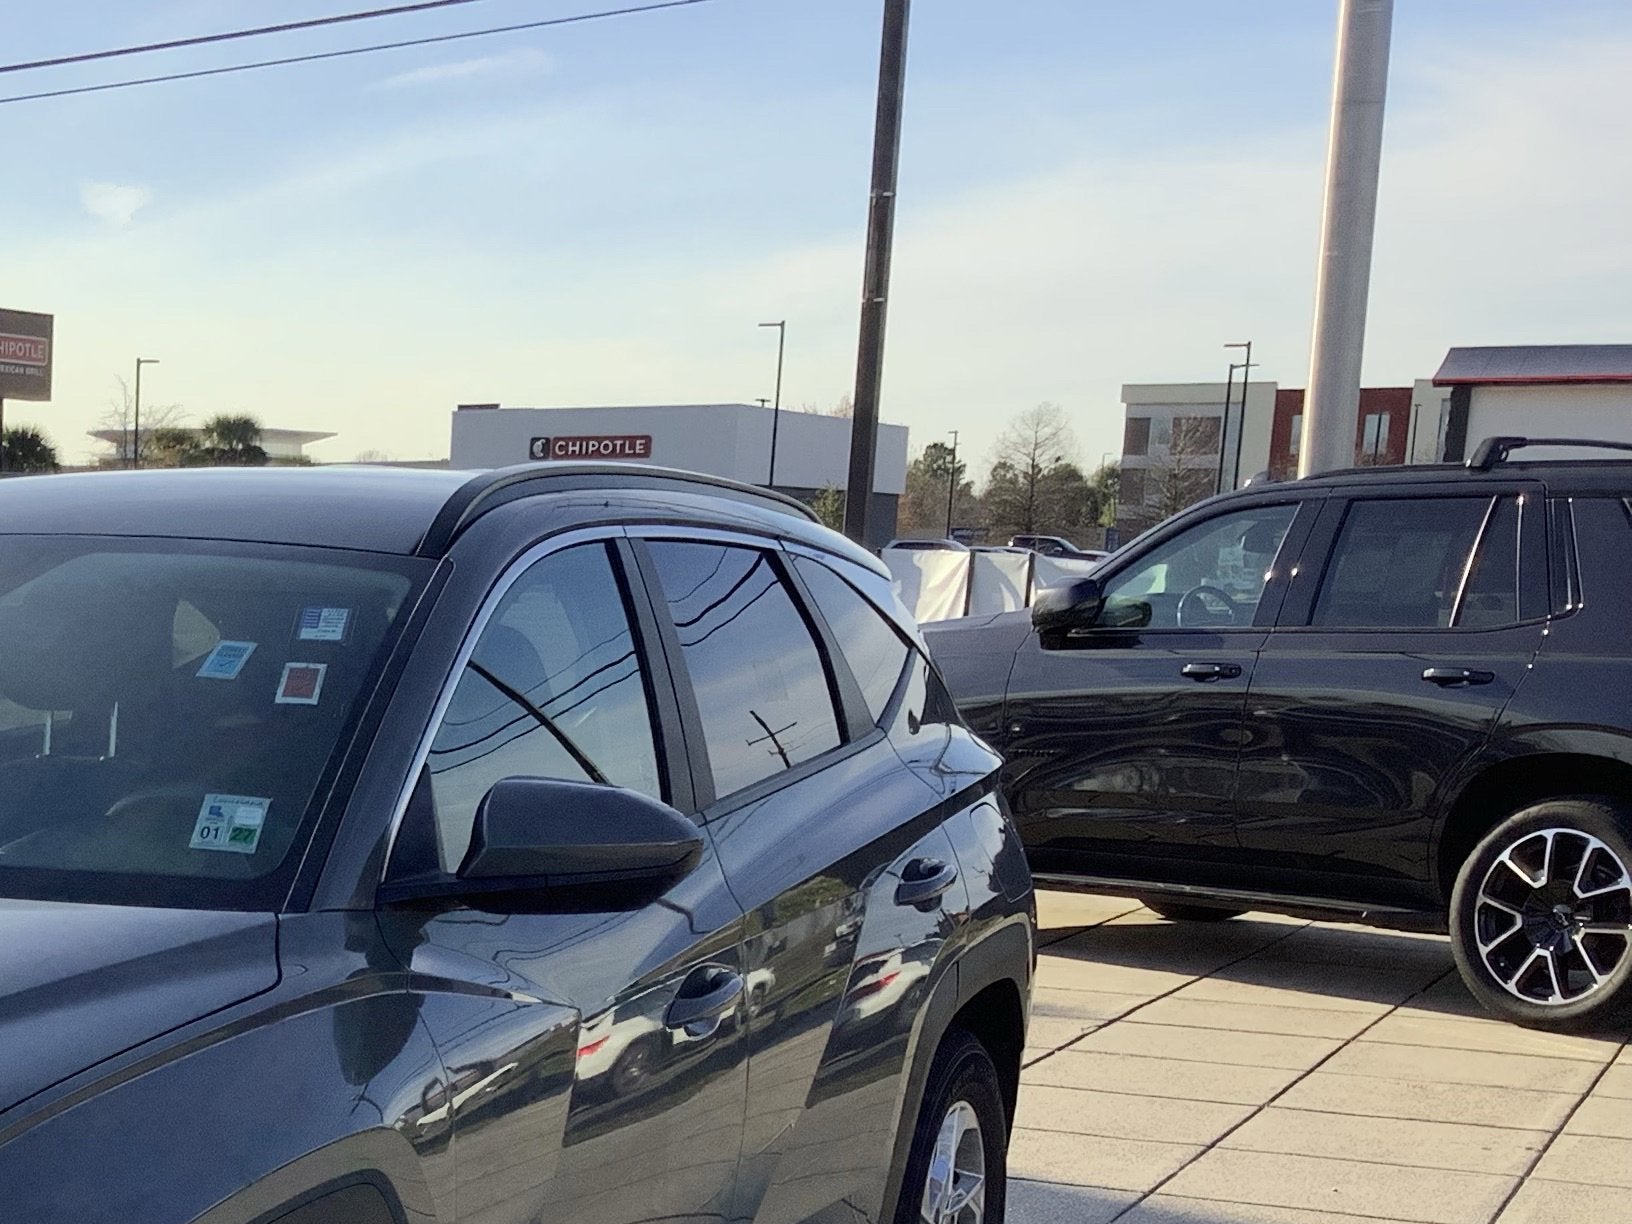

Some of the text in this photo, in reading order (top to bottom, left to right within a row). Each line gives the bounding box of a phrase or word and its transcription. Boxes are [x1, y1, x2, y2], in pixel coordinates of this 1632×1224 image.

[25, 367, 43, 376] GRILL
[555, 439, 646, 455] CHIPOTLE
[200, 825, 257, 844] 01 27
